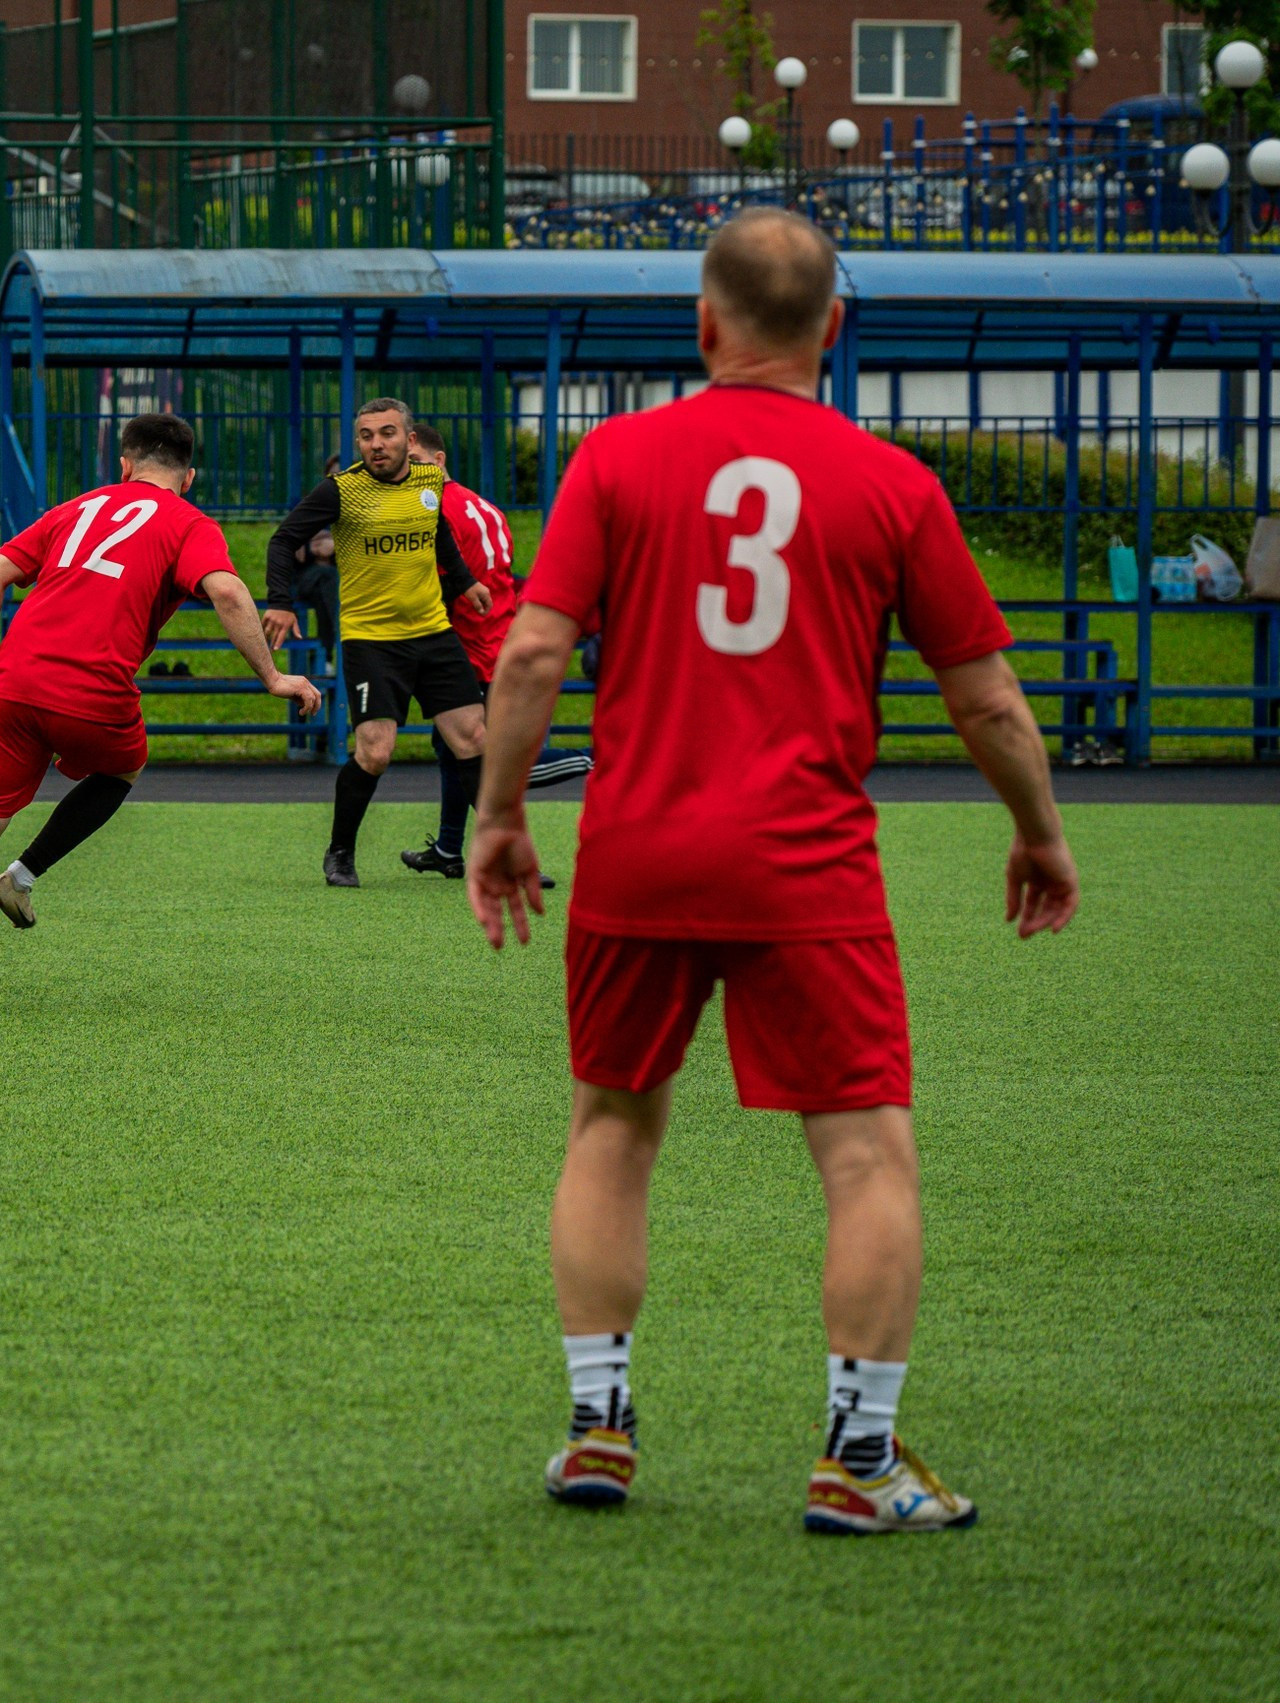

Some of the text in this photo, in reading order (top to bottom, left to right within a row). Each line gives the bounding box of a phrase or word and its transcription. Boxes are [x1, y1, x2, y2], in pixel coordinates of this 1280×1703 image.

[57, 495, 159, 579] 12
[465, 498, 511, 571] 11
[695, 455, 801, 656] 3
